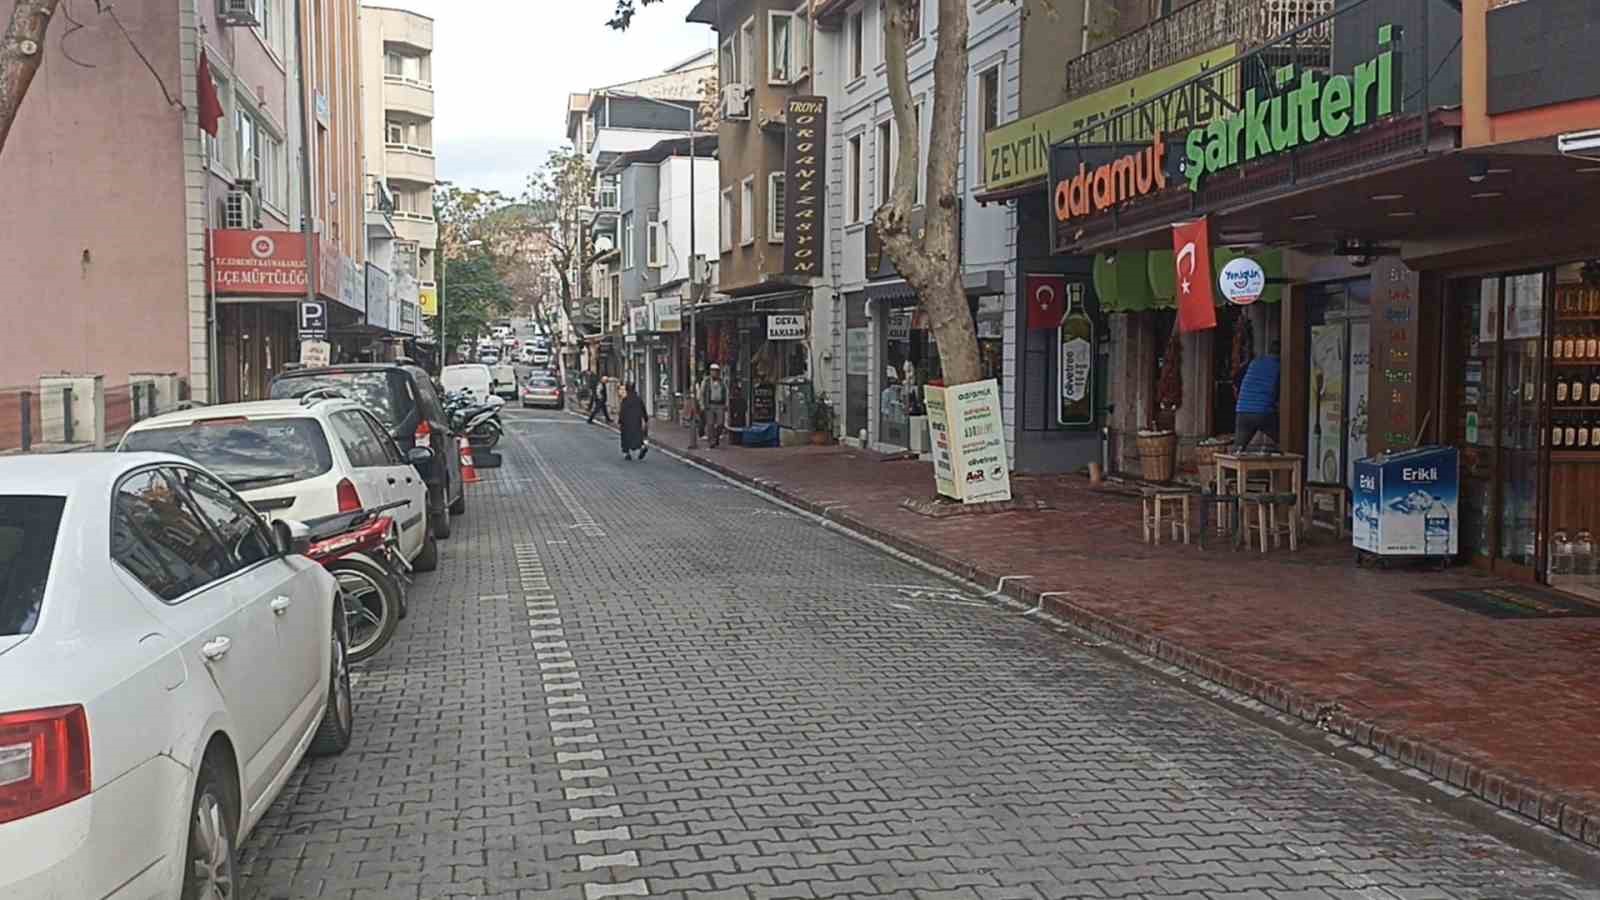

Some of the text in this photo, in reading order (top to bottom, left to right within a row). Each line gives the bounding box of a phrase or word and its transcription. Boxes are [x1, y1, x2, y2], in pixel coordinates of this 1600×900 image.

[789, 101, 822, 113] TROYA
[1055, 24, 1392, 222] adramut şarküteri
[991, 122, 1050, 179] ZEYTİN
[302, 303, 322, 327] P
[1403, 466, 1438, 481] Erikli
